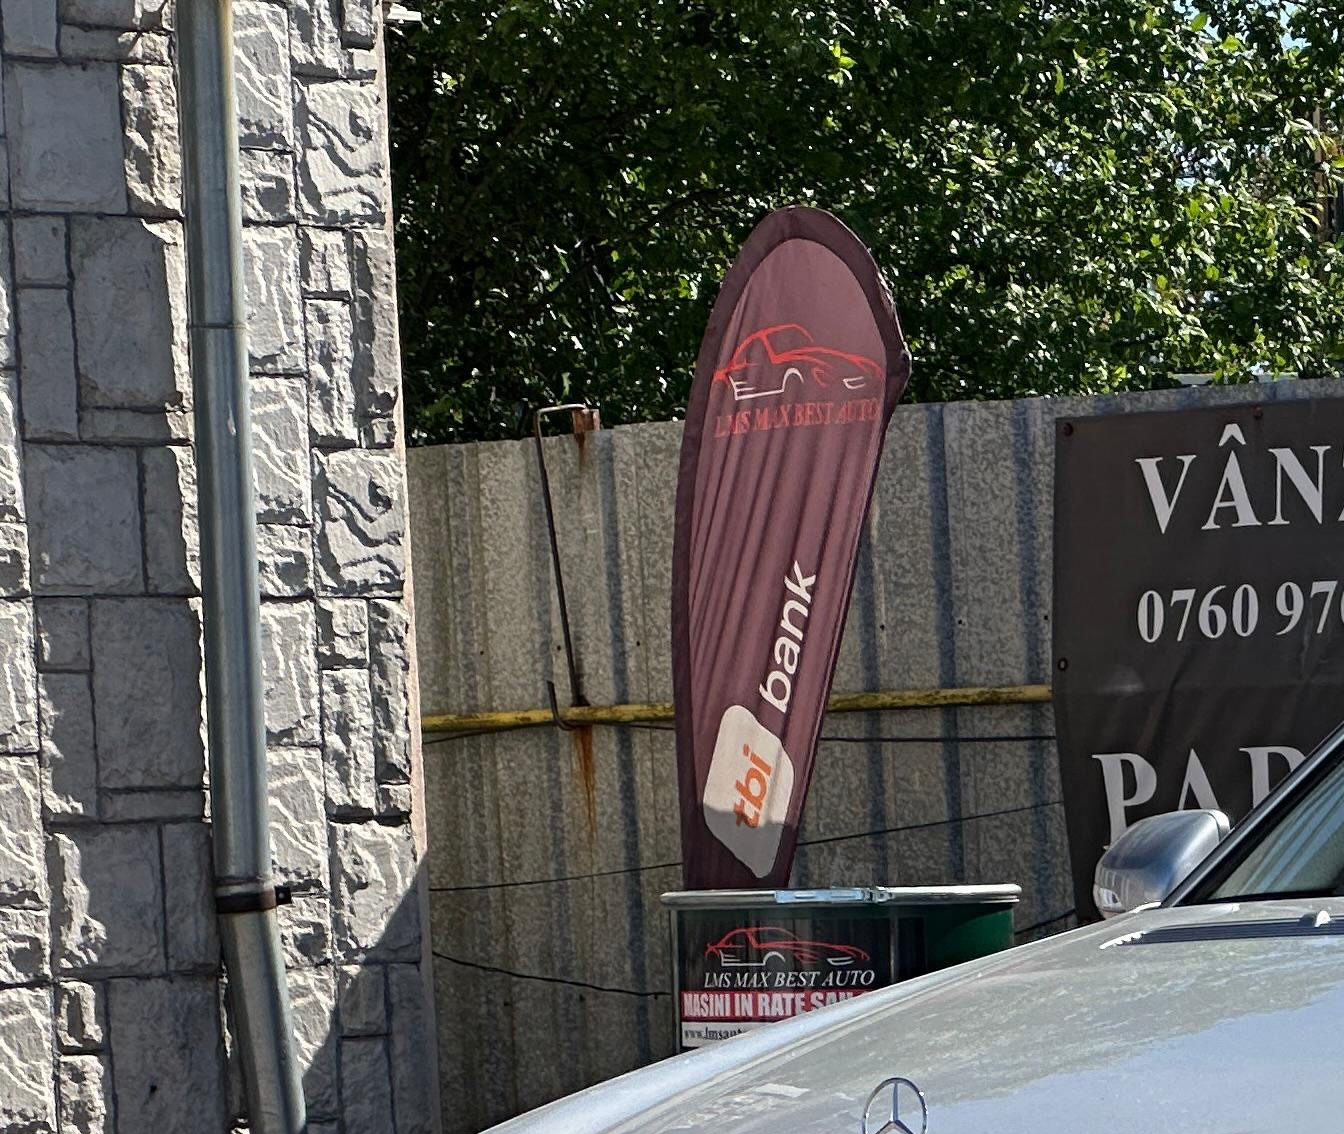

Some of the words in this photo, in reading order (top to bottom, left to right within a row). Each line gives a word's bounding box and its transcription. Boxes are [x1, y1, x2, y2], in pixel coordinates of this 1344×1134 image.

[714, 411, 752, 438] LMS
[753, 404, 791, 431] MAX
[793, 401, 834, 427] BEST
[836, 398, 880, 425] AUTO
[759, 560, 817, 714] bank
[1137, 584, 1259, 644] 0760
[732, 743, 772, 829] tbi
[704, 971, 732, 988] LMS
[733, 971, 772, 988] MAX
[774, 971, 820, 987] BEST
[822, 969, 875, 986] AUTO
[734, 992, 753, 1017] IN
[757, 991, 806, 1017] RATE
